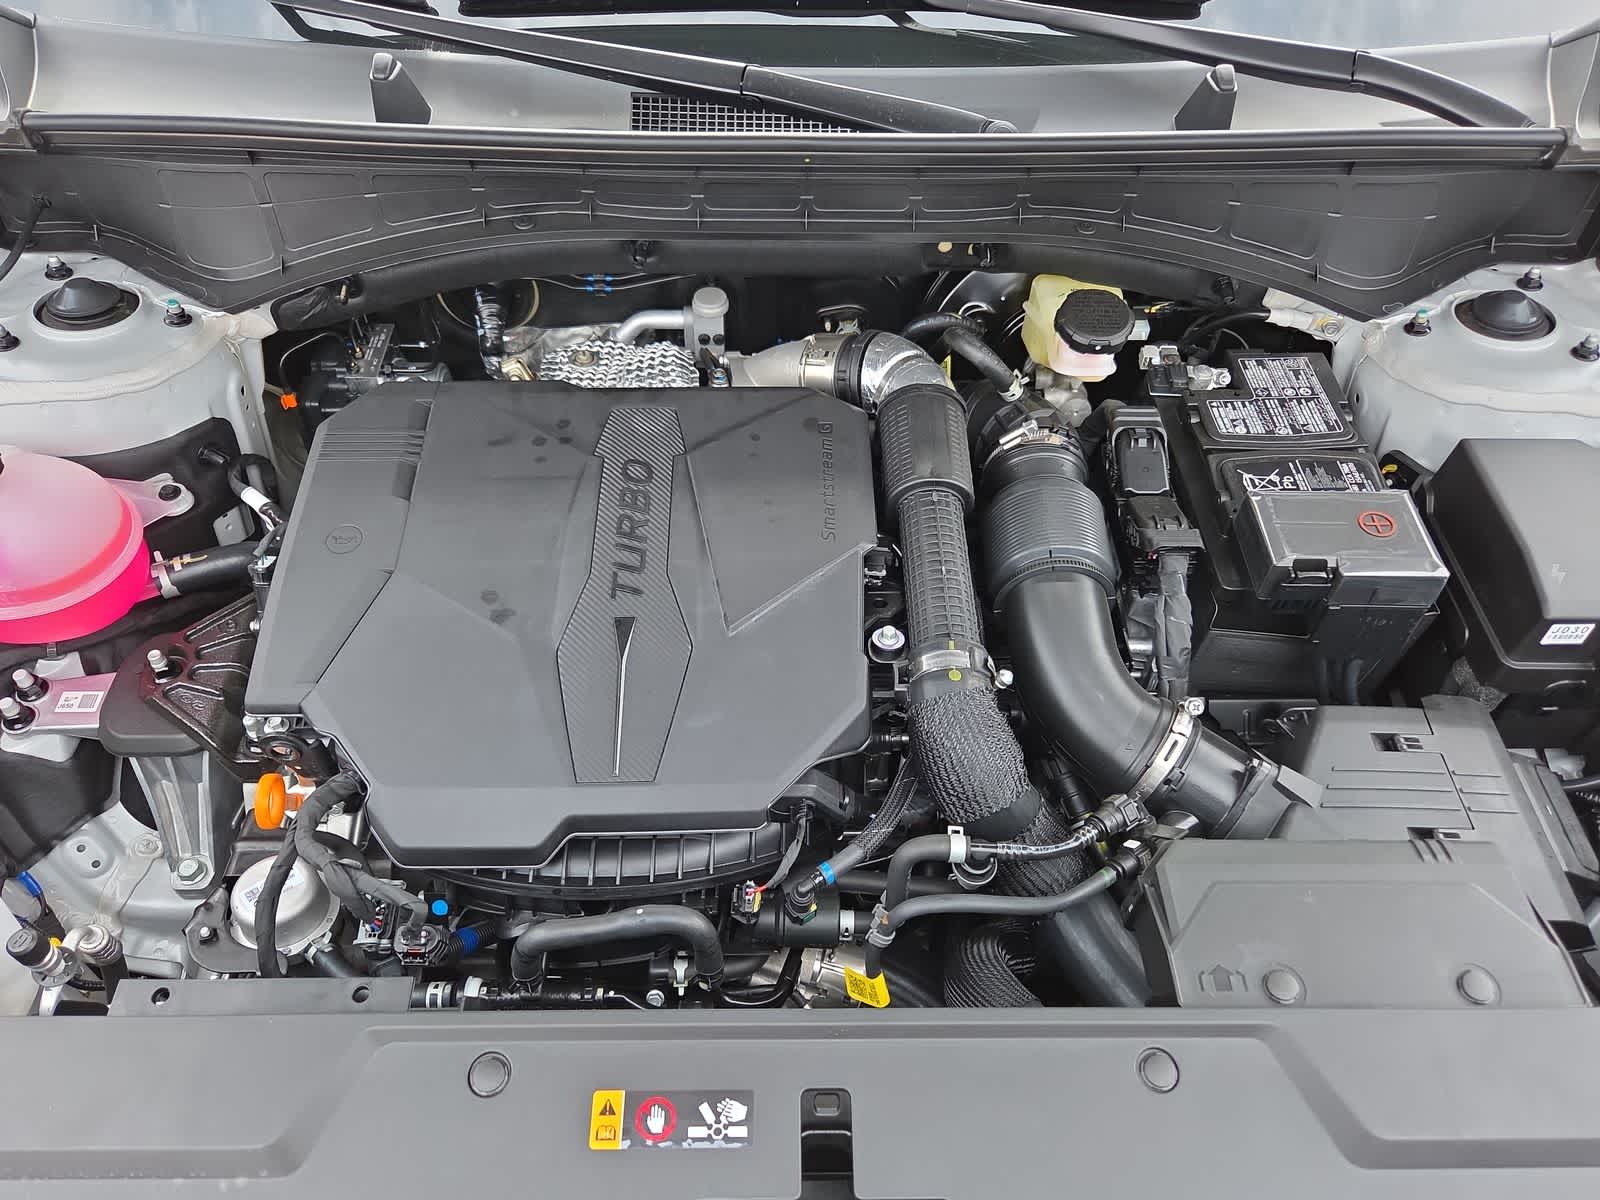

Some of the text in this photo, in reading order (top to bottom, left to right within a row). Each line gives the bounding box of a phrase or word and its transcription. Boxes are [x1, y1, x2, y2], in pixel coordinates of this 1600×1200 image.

[821, 436, 836, 541] Smartstream
[1281, 475, 1297, 489] Pb
[610, 458, 653, 600] TURBO
[1551, 626, 1590, 634] J030
